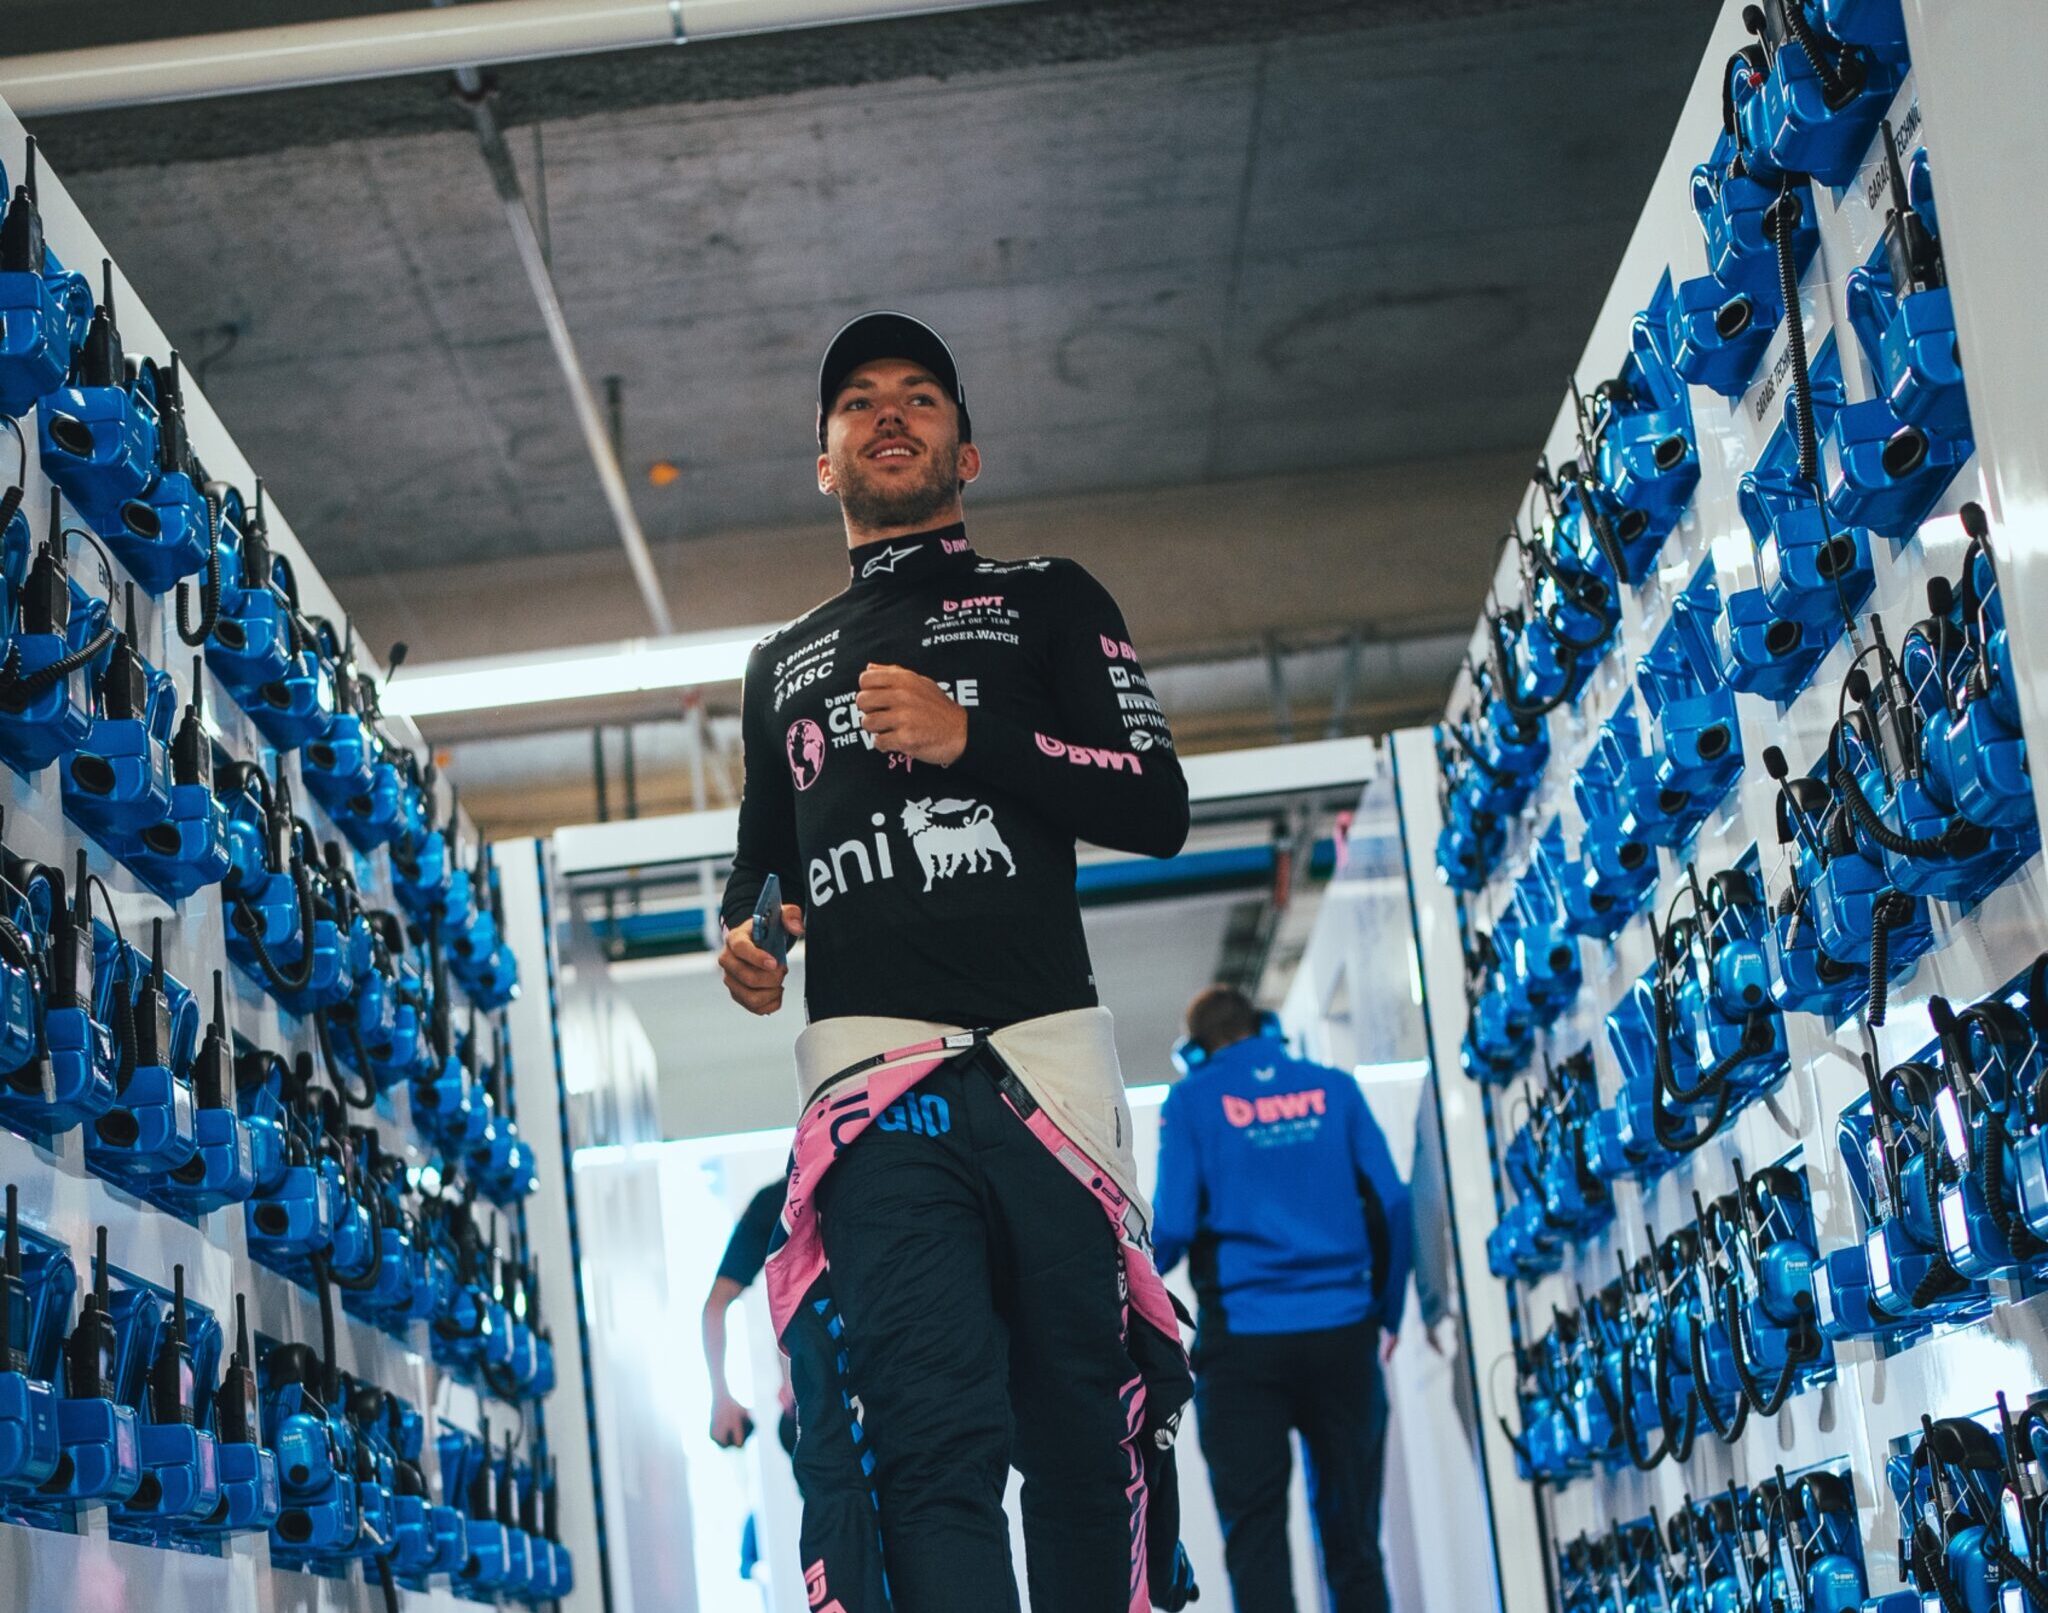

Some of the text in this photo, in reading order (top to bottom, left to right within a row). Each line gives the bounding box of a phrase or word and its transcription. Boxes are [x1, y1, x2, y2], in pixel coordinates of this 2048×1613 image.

[924, 608, 1020, 626] ALPINE
[961, 596, 1005, 609] BWT
[932, 618, 966, 630] FORMULA
[990, 616, 1011, 626] TEAM
[786, 629, 840, 666] BINANCE
[785, 661, 834, 700] MSC
[832, 732, 858, 749] THE
[1066, 744, 1143, 776] BWT
[808, 812, 895, 907] eni
[1255, 1088, 1326, 1124] BWT
